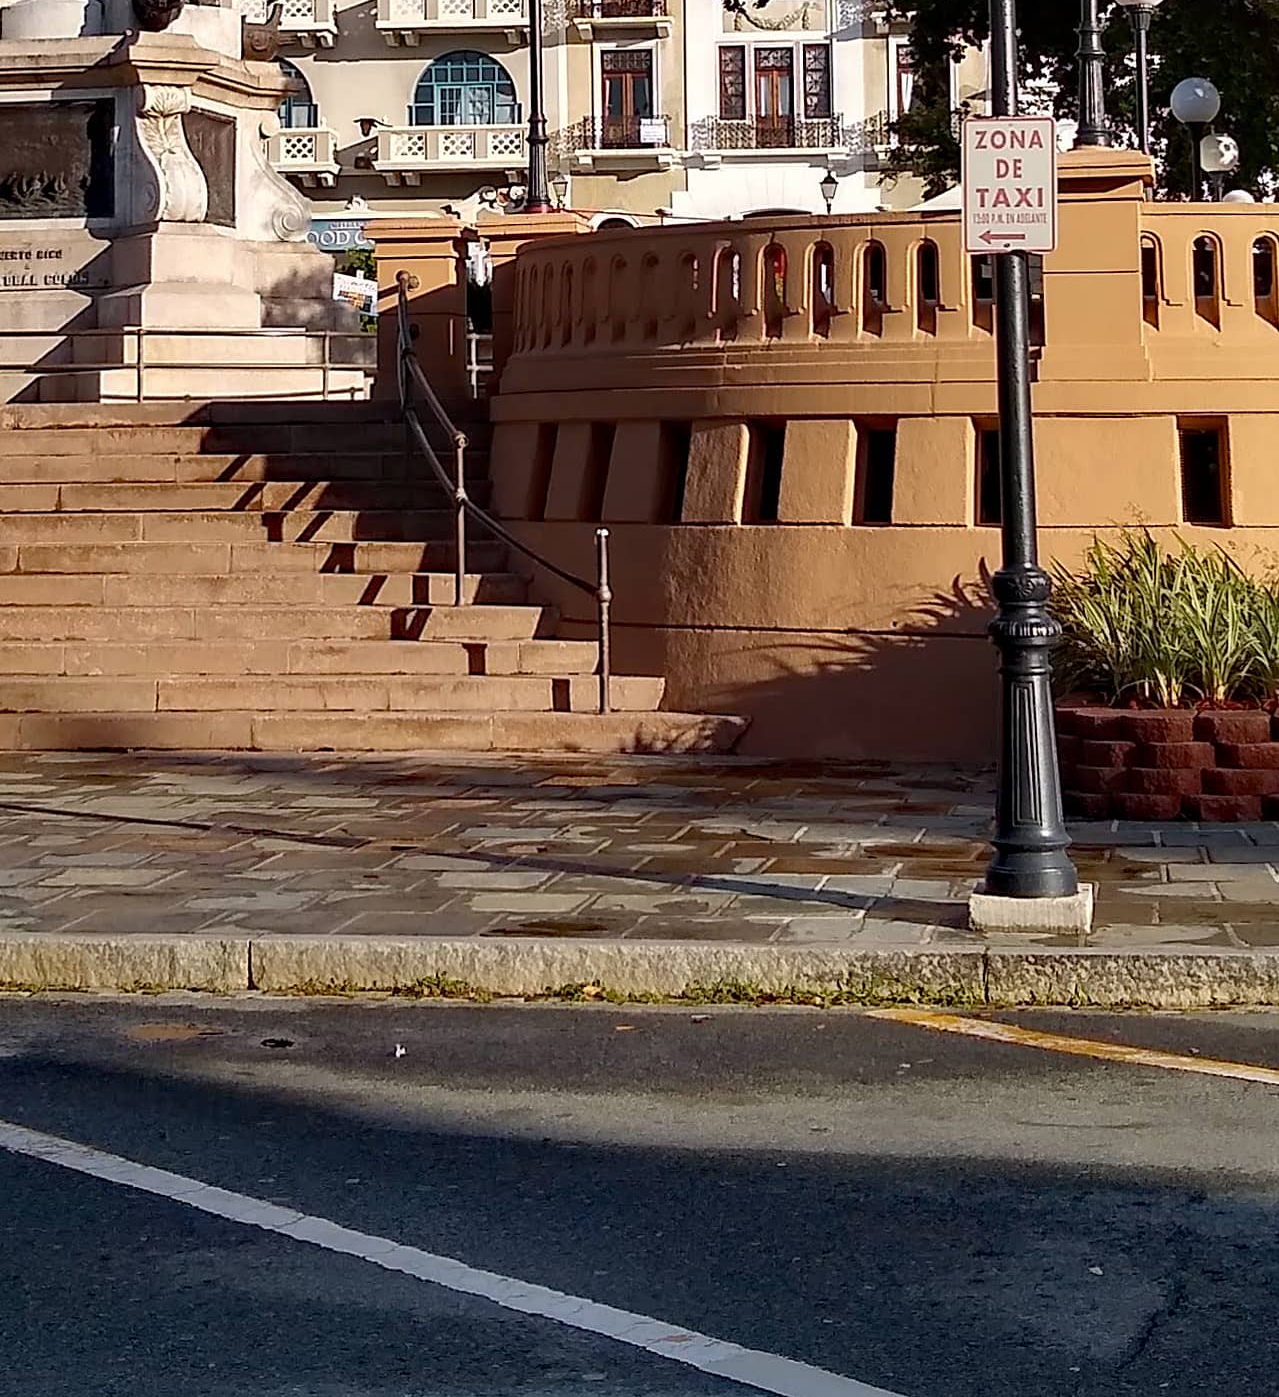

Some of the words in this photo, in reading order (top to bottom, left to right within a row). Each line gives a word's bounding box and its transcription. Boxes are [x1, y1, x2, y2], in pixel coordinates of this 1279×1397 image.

[974, 130, 1044, 149] ZONA
[996, 158, 1023, 179] DE
[975, 187, 1044, 208] TAXI
[1006, 213, 1015, 224] EN
[1016, 213, 1047, 224] ADELANTE
[306, 230, 351, 245] OOD
